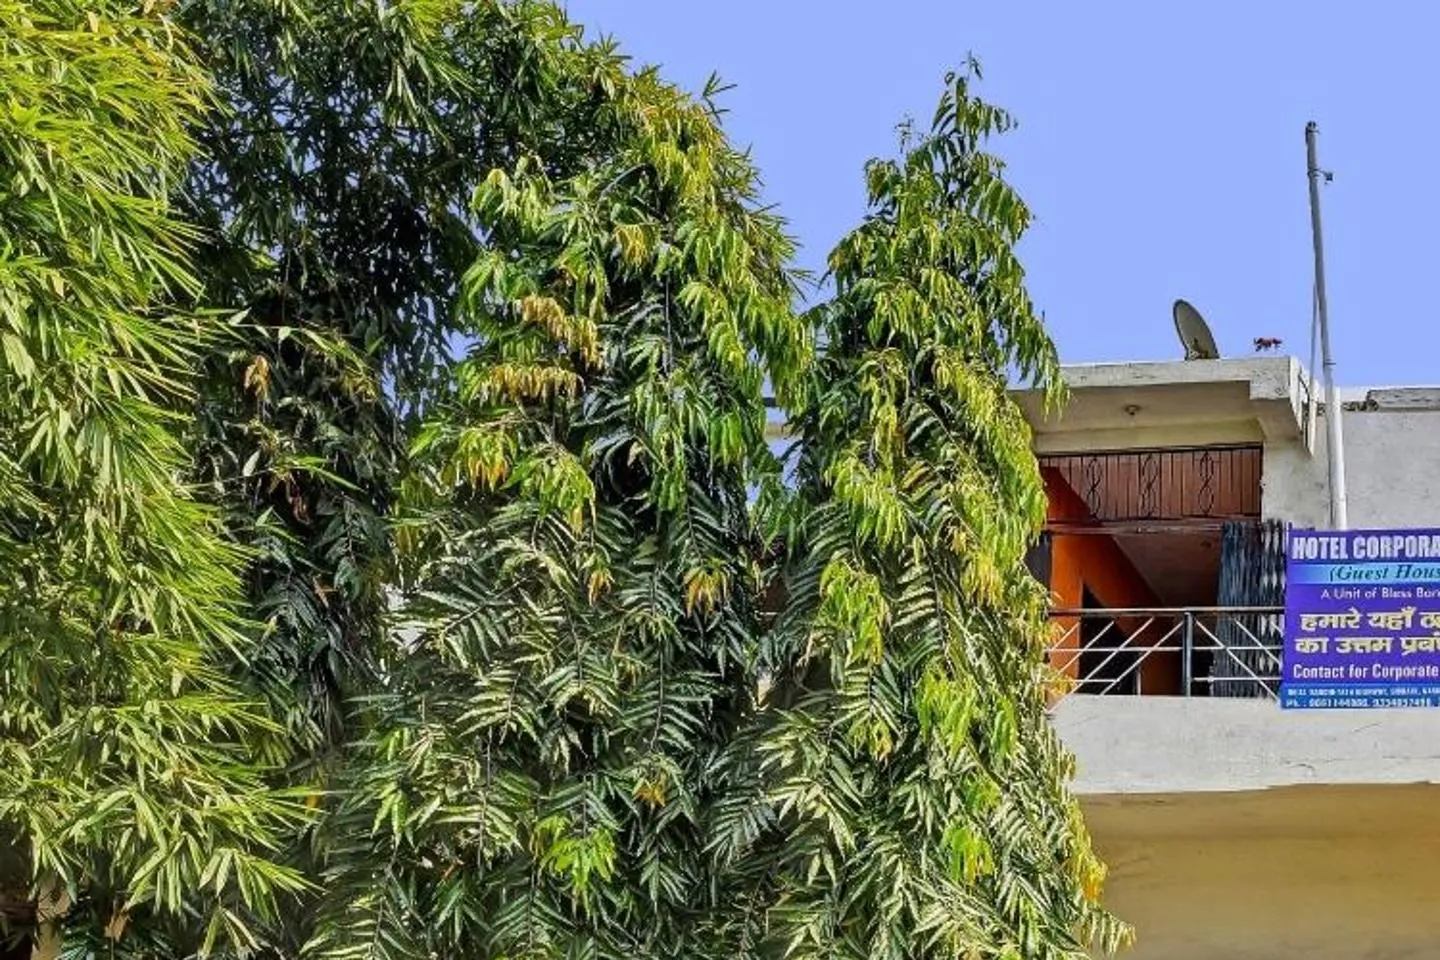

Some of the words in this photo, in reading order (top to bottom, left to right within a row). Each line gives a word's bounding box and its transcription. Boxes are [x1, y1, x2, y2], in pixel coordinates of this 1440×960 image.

[1292, 536, 1348, 560] HOTEL
[1329, 564, 1388, 582] (Guest
[1320, 588, 1331, 600] A
[1333, 587, 1361, 599] Unit
[1364, 587, 1378, 599] of
[1300, 607, 1363, 632] हमारे
[1294, 636, 1329, 654] का
[1334, 636, 1393, 654] उत्तम
[1293, 664, 1344, 679] Contact
[1349, 664, 1368, 679] for
[1372, 663, 1438, 681] Corporate
